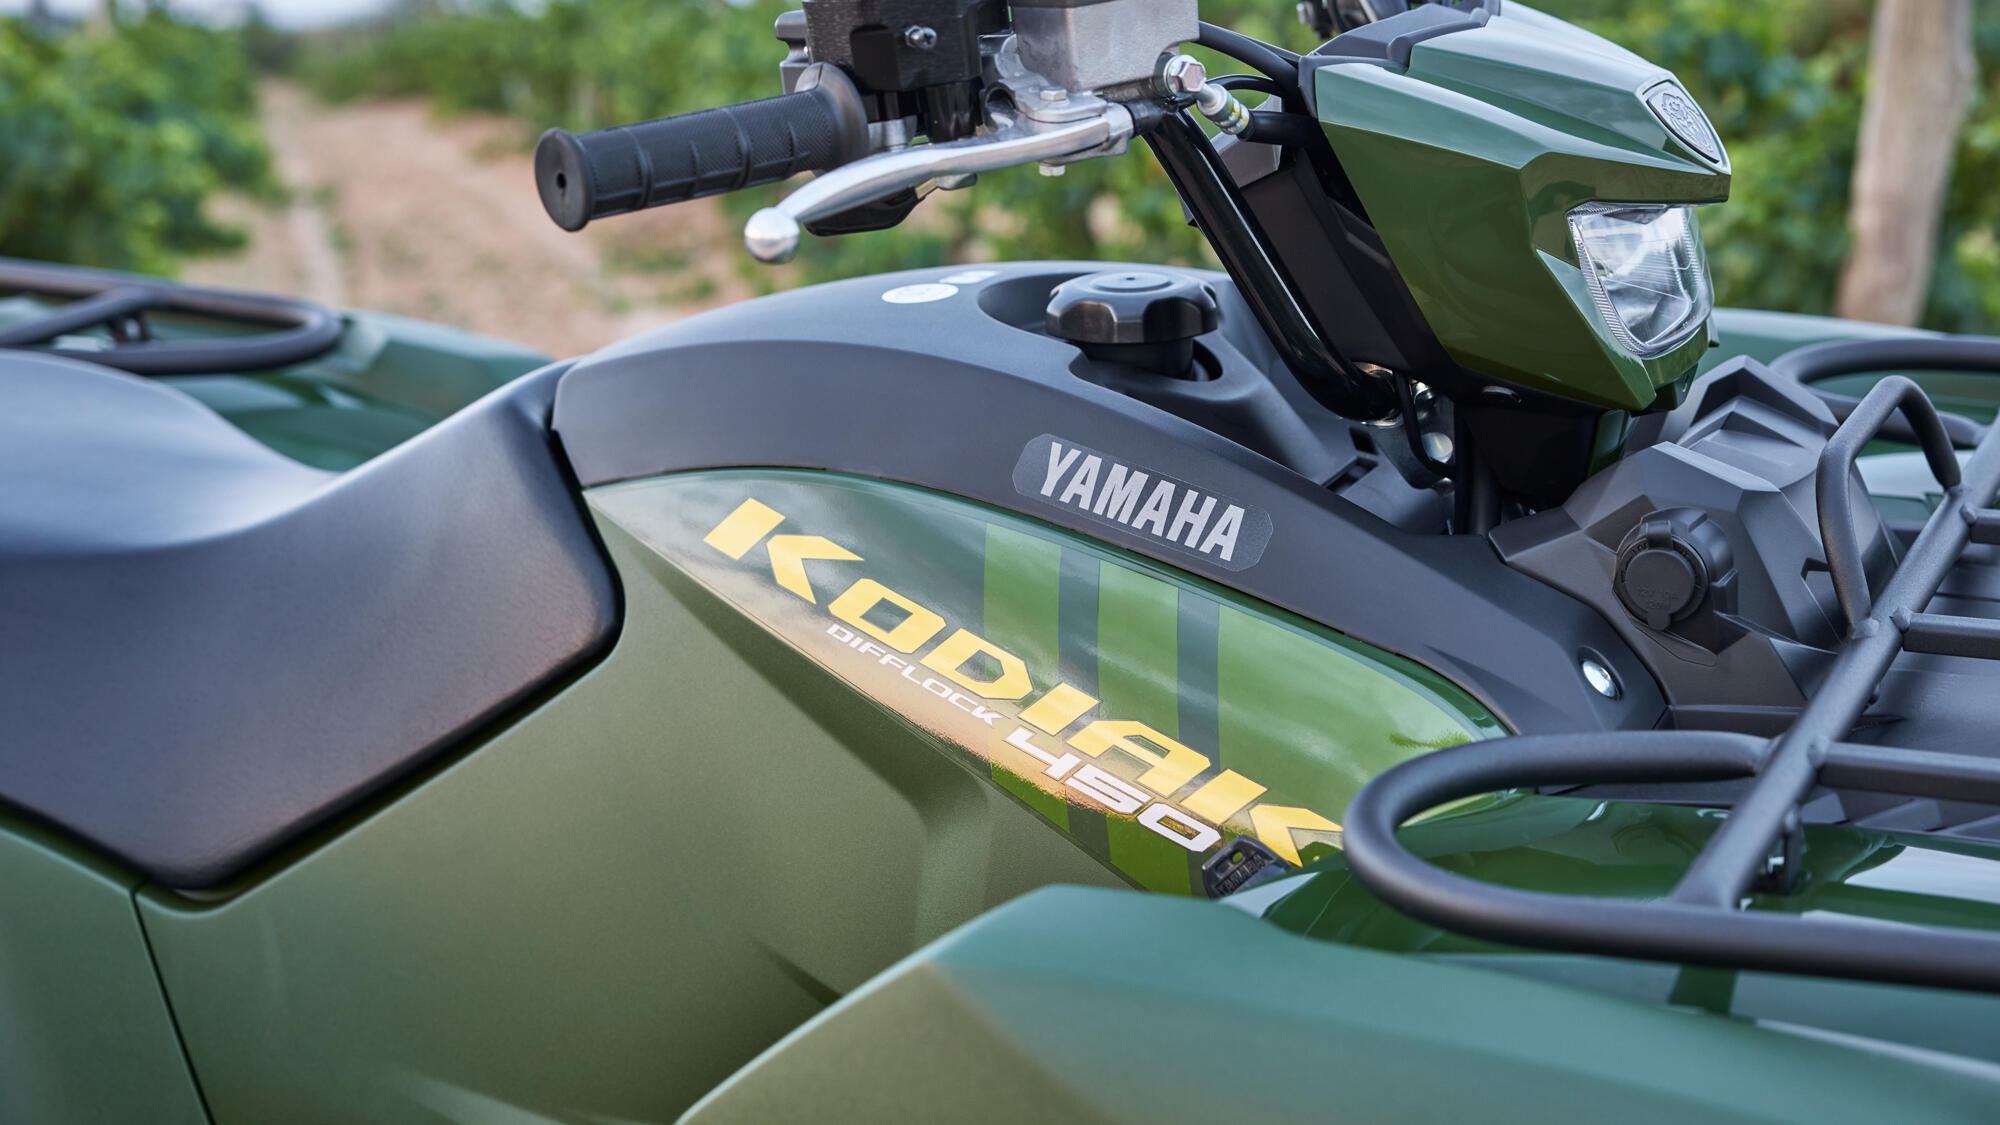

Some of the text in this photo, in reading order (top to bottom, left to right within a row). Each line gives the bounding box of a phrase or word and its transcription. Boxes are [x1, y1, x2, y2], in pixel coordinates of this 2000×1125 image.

[1040, 442, 1245, 562] YAMAHA
[703, 498, 1343, 867] KODIAK
[826, 623, 1222, 852] DIFFLOCK 450
